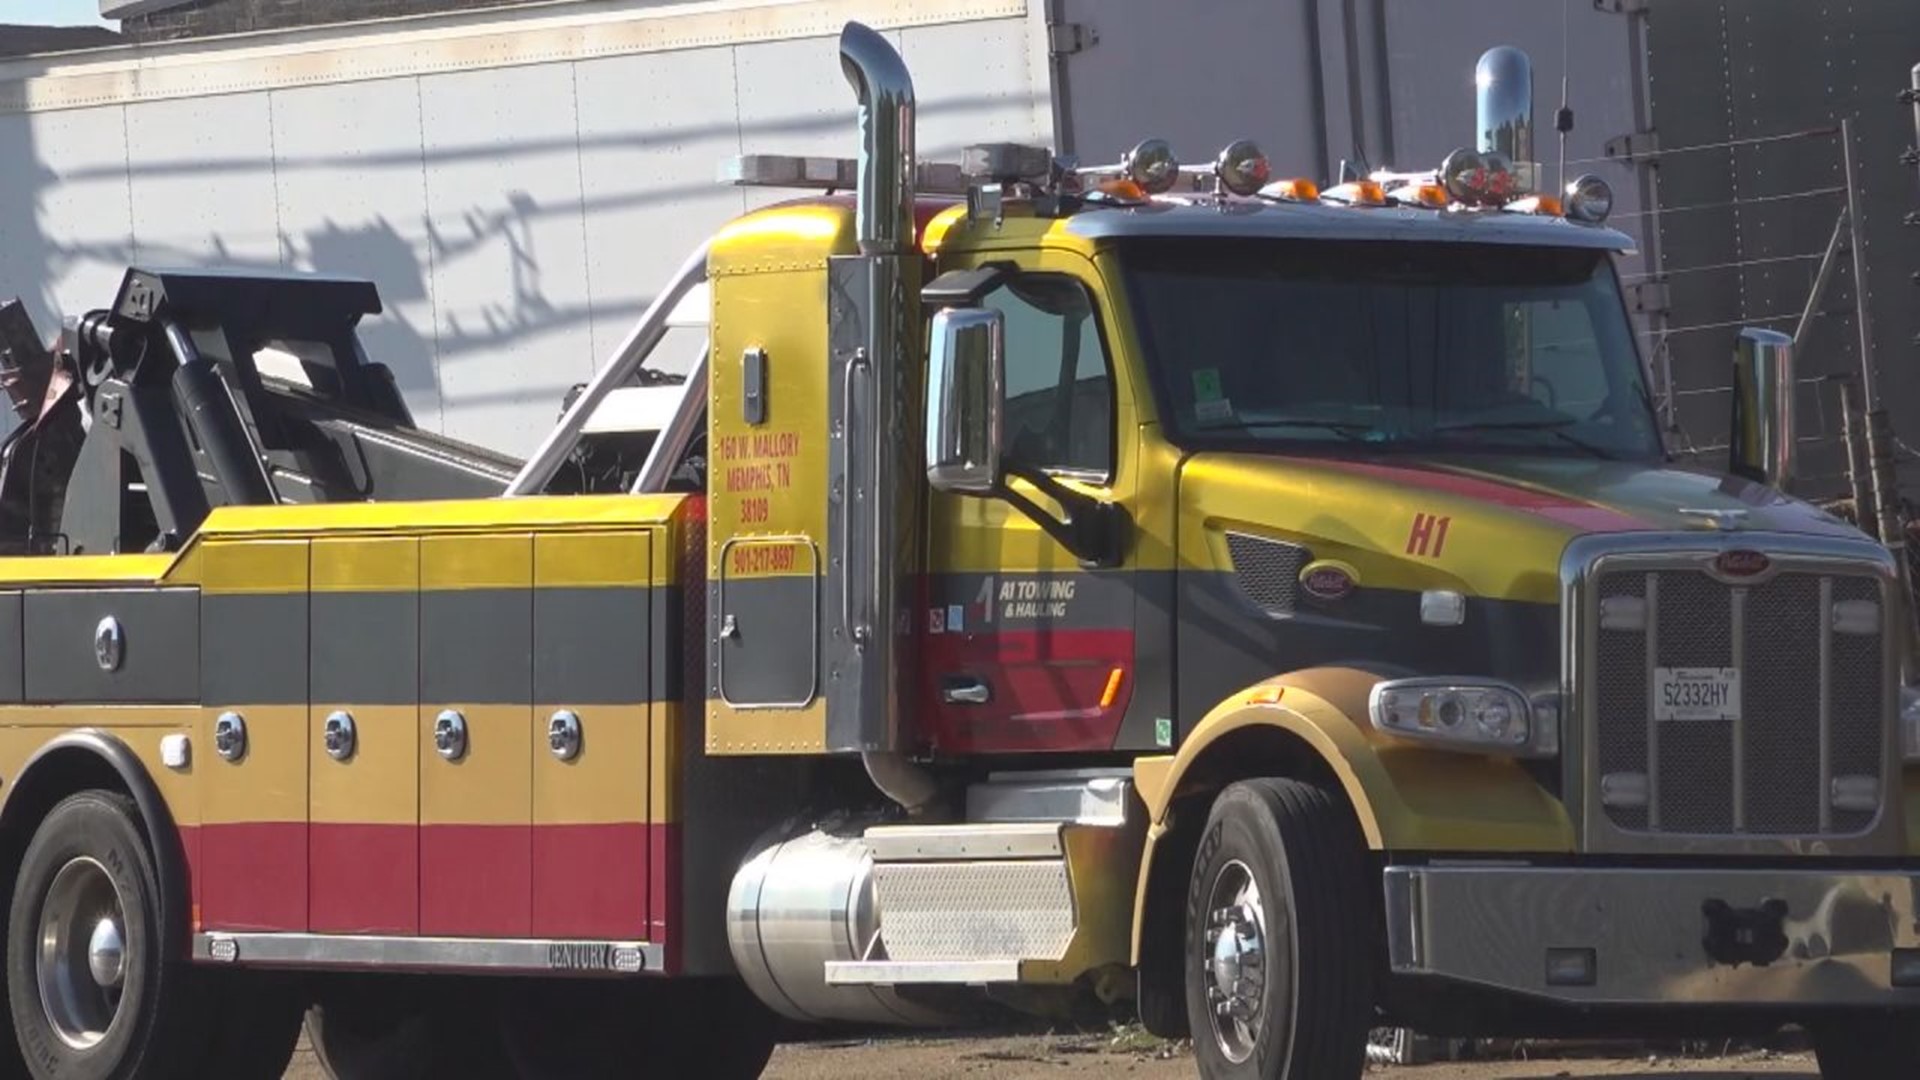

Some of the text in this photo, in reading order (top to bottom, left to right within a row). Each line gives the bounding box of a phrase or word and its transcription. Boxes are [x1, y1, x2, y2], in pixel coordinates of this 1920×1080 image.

[720, 432, 799, 460] 160 W. MALLORY
[727, 462, 790, 492] MEMPHIS, TN
[741, 498, 769, 523] 38109
[1405, 512, 1452, 558] H1
[999, 580, 1076, 600] A1 TOWING
[1004, 601, 1067, 618] & HAULING
[548, 943, 609, 969] CENTURY
